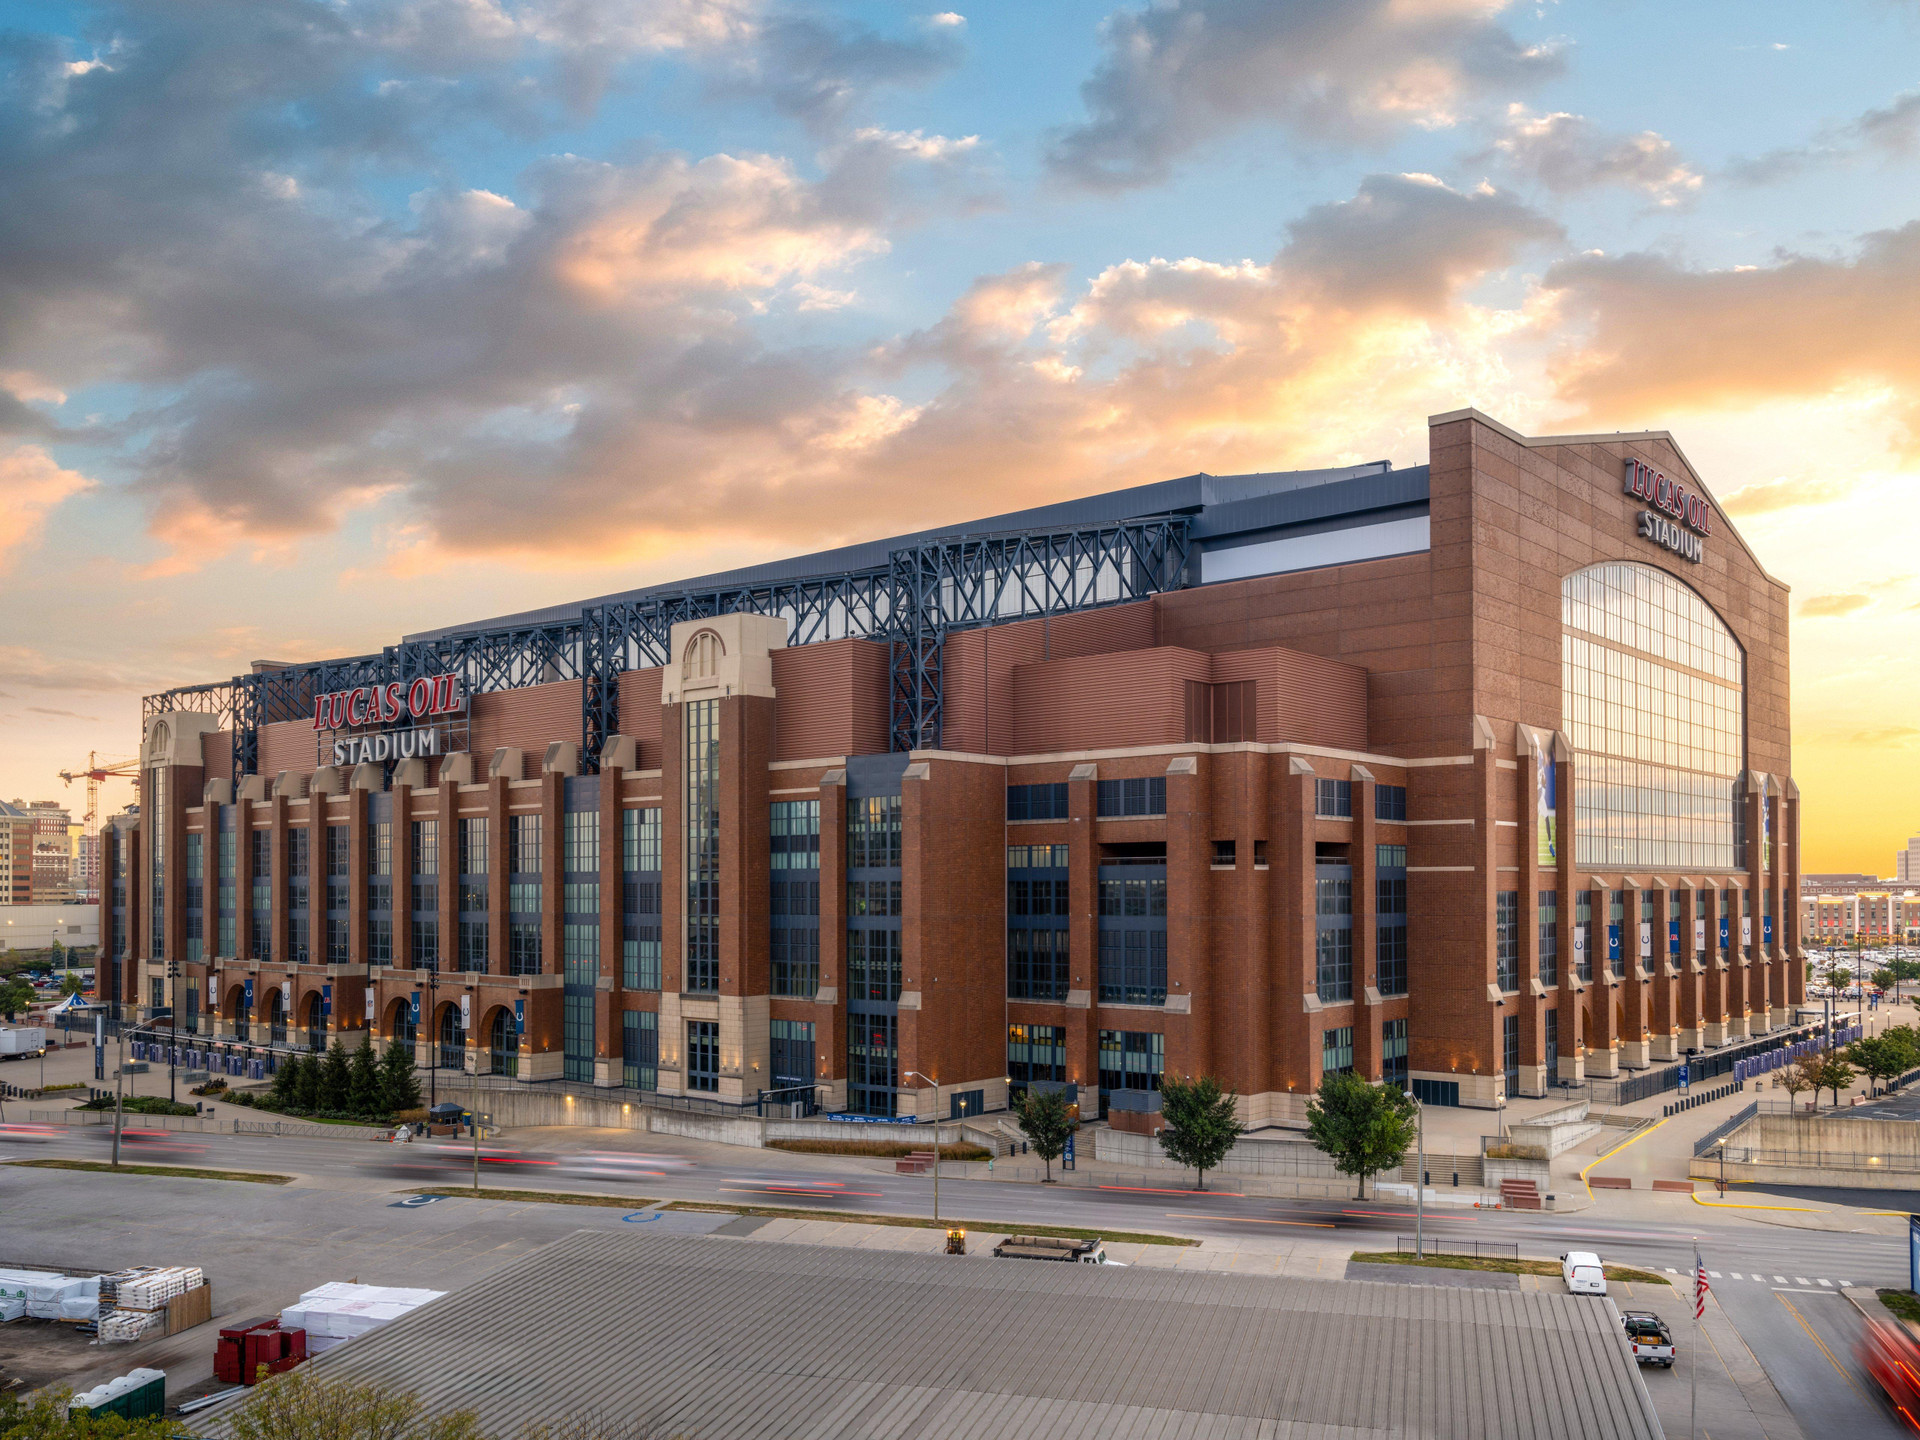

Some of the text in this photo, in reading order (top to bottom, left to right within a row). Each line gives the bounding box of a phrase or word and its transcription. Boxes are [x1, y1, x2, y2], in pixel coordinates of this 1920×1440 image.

[1631, 457, 1712, 537] LUCAS OIL
[1644, 509, 1703, 563] STADIUM
[312, 672, 461, 732] LUCAS OIL
[334, 727, 436, 766] STADIUM
